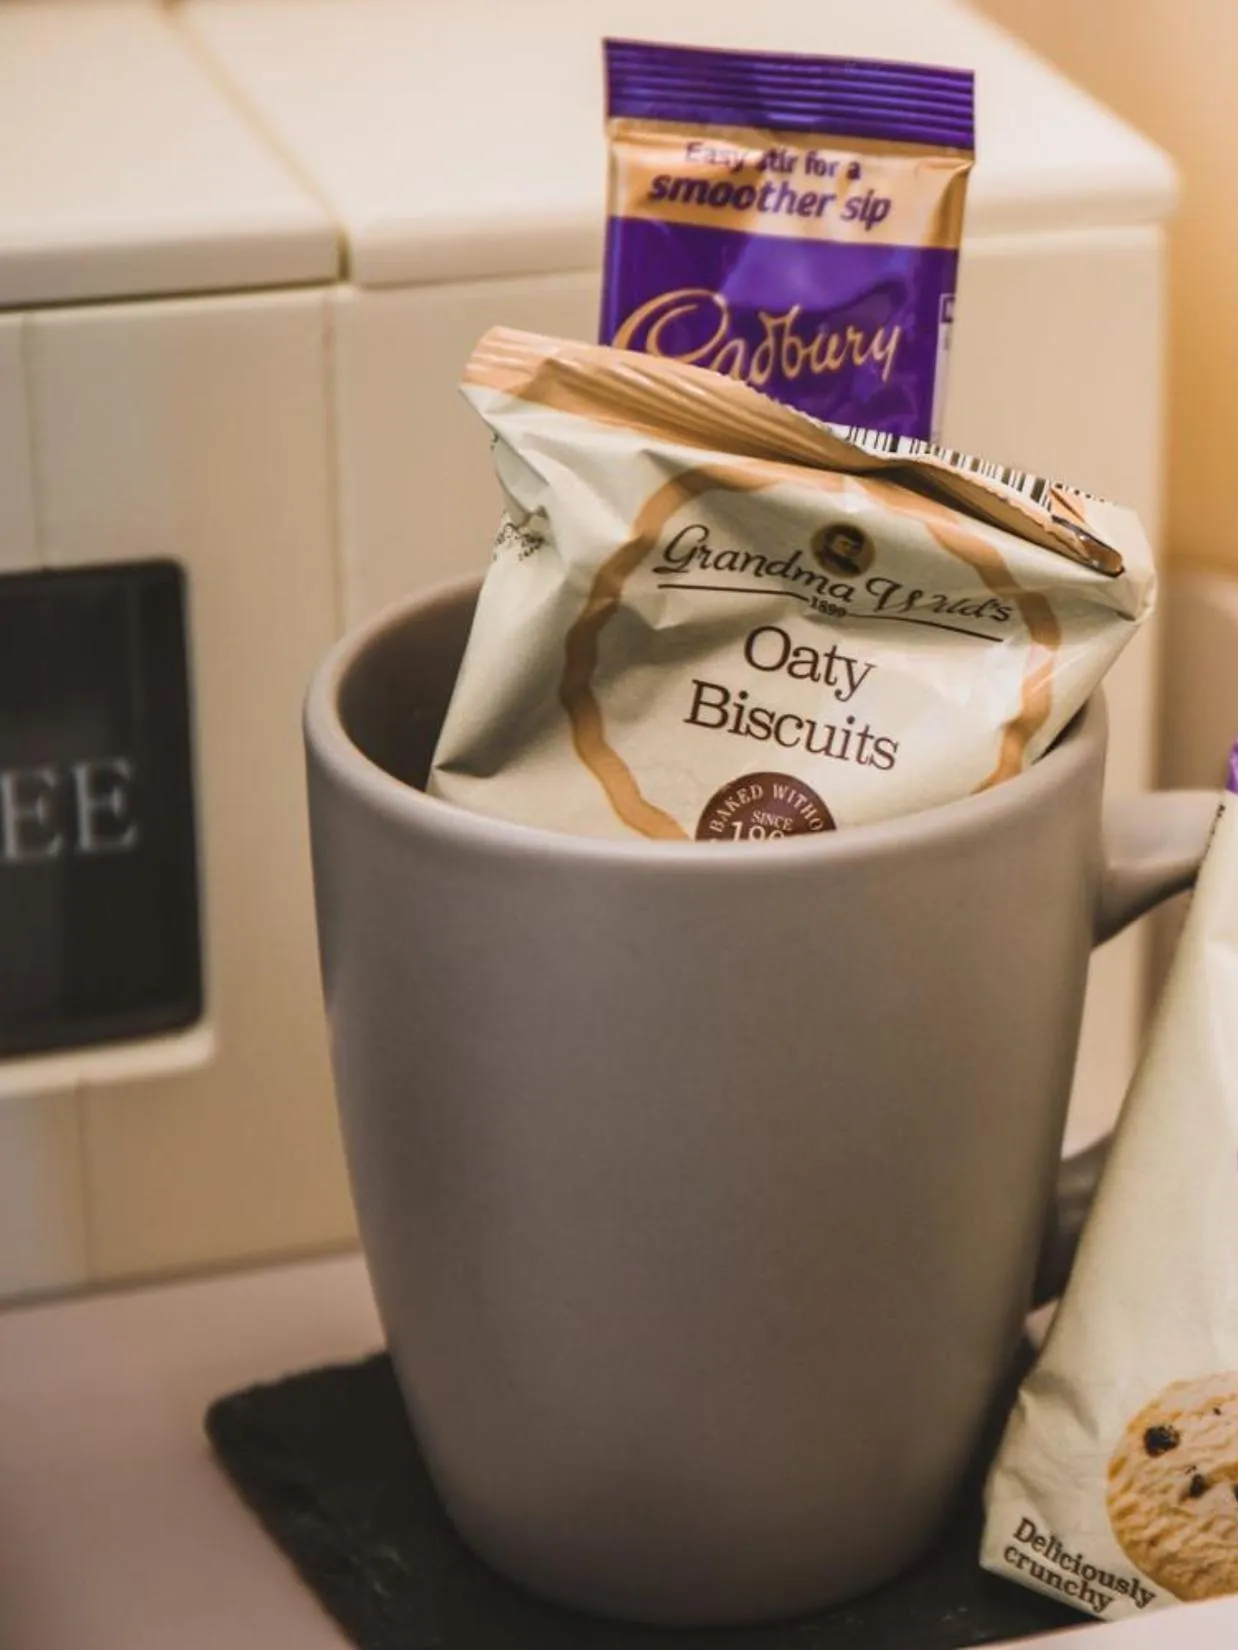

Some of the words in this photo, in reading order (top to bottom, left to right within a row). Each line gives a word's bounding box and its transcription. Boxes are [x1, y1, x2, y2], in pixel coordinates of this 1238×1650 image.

[804, 150, 839, 177] for
[846, 161, 861, 180] a
[647, 174, 836, 218] smoother
[840, 188, 892, 231] sip
[611, 288, 901, 386] Cadbury
[652, 524, 857, 603] Grandma
[866, 577, 1014, 622] Wild's
[743, 625, 877, 702] Oaty
[683, 678, 900, 771] Biscuits
[709, 783, 764, 833] BAKED
[772, 782, 824, 831] WITHO
[751, 809, 794, 832] SINCE
[1003, 1545, 1115, 1613] crunchy
[1012, 1517, 1157, 1610] Deliciously
